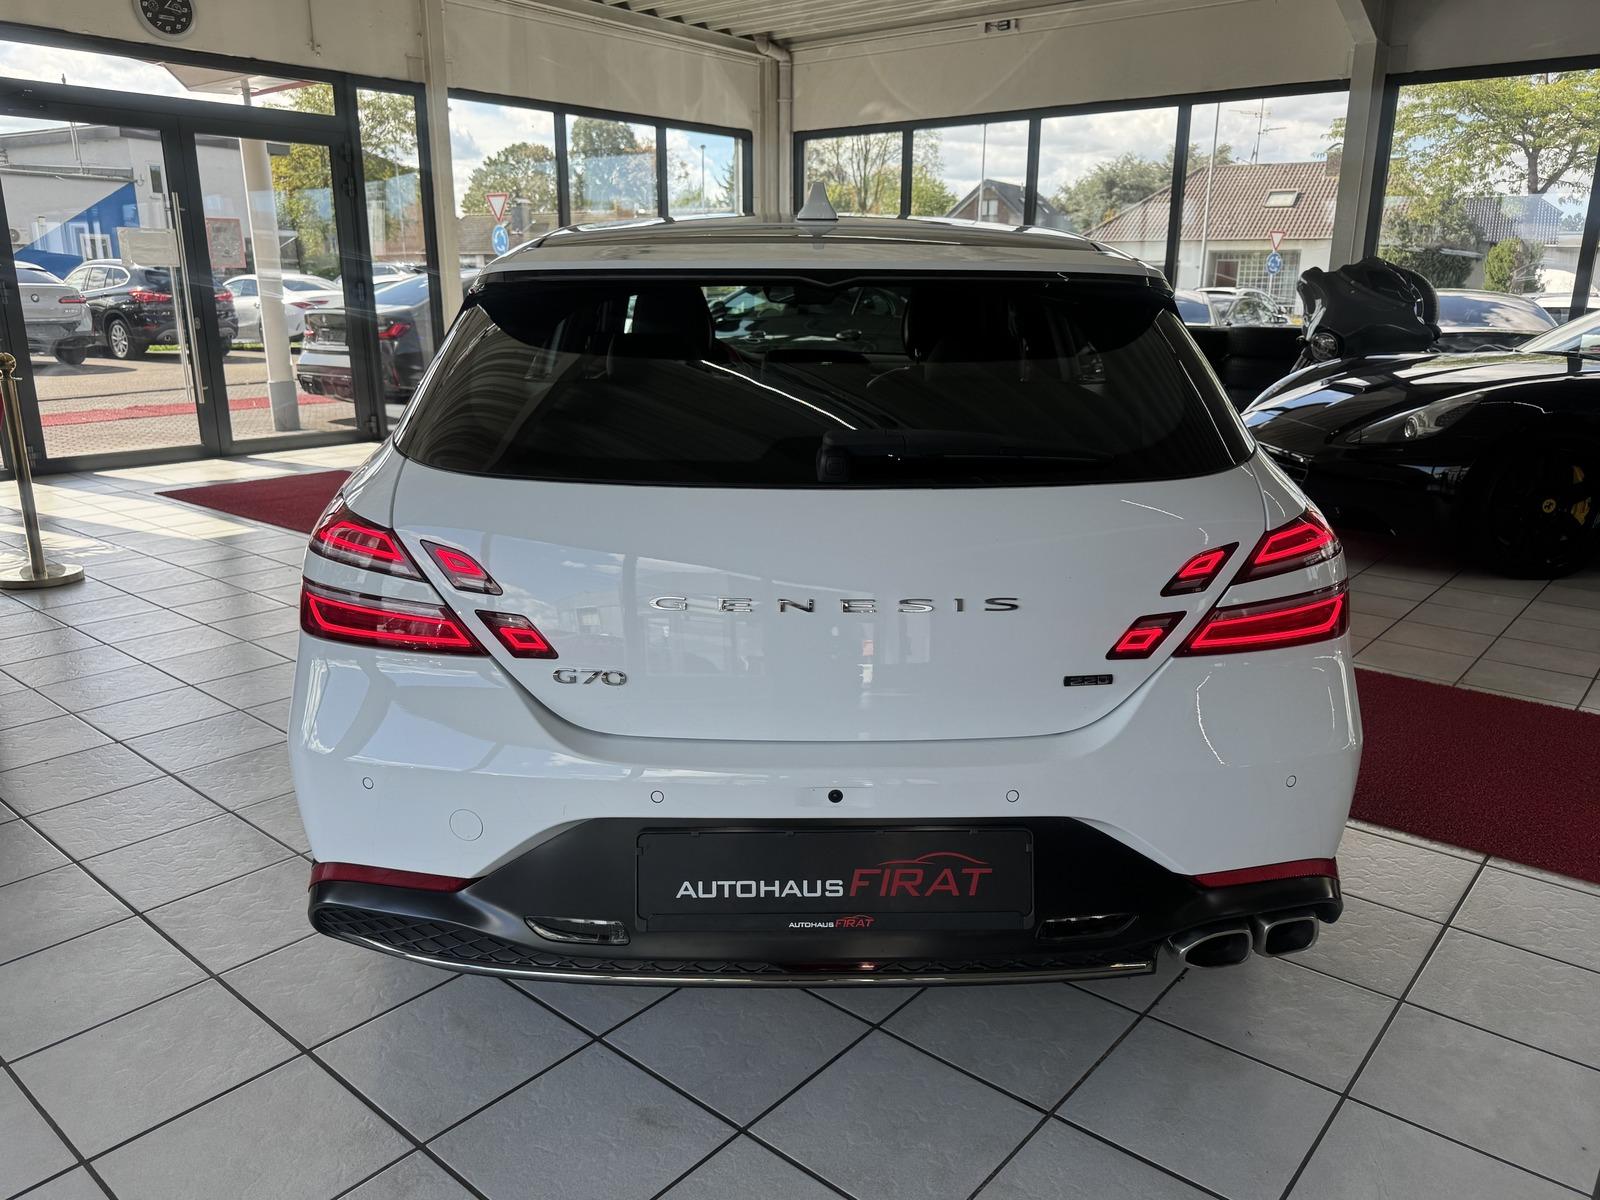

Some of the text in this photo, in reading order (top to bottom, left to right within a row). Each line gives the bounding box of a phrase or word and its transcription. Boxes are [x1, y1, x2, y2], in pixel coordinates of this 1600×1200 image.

[648, 597, 1020, 613] GENESIS
[552, 668, 628, 686] G70
[675, 867, 993, 899] AUTOHAUS FIRAT
[834, 918, 875, 928] FIRAT
